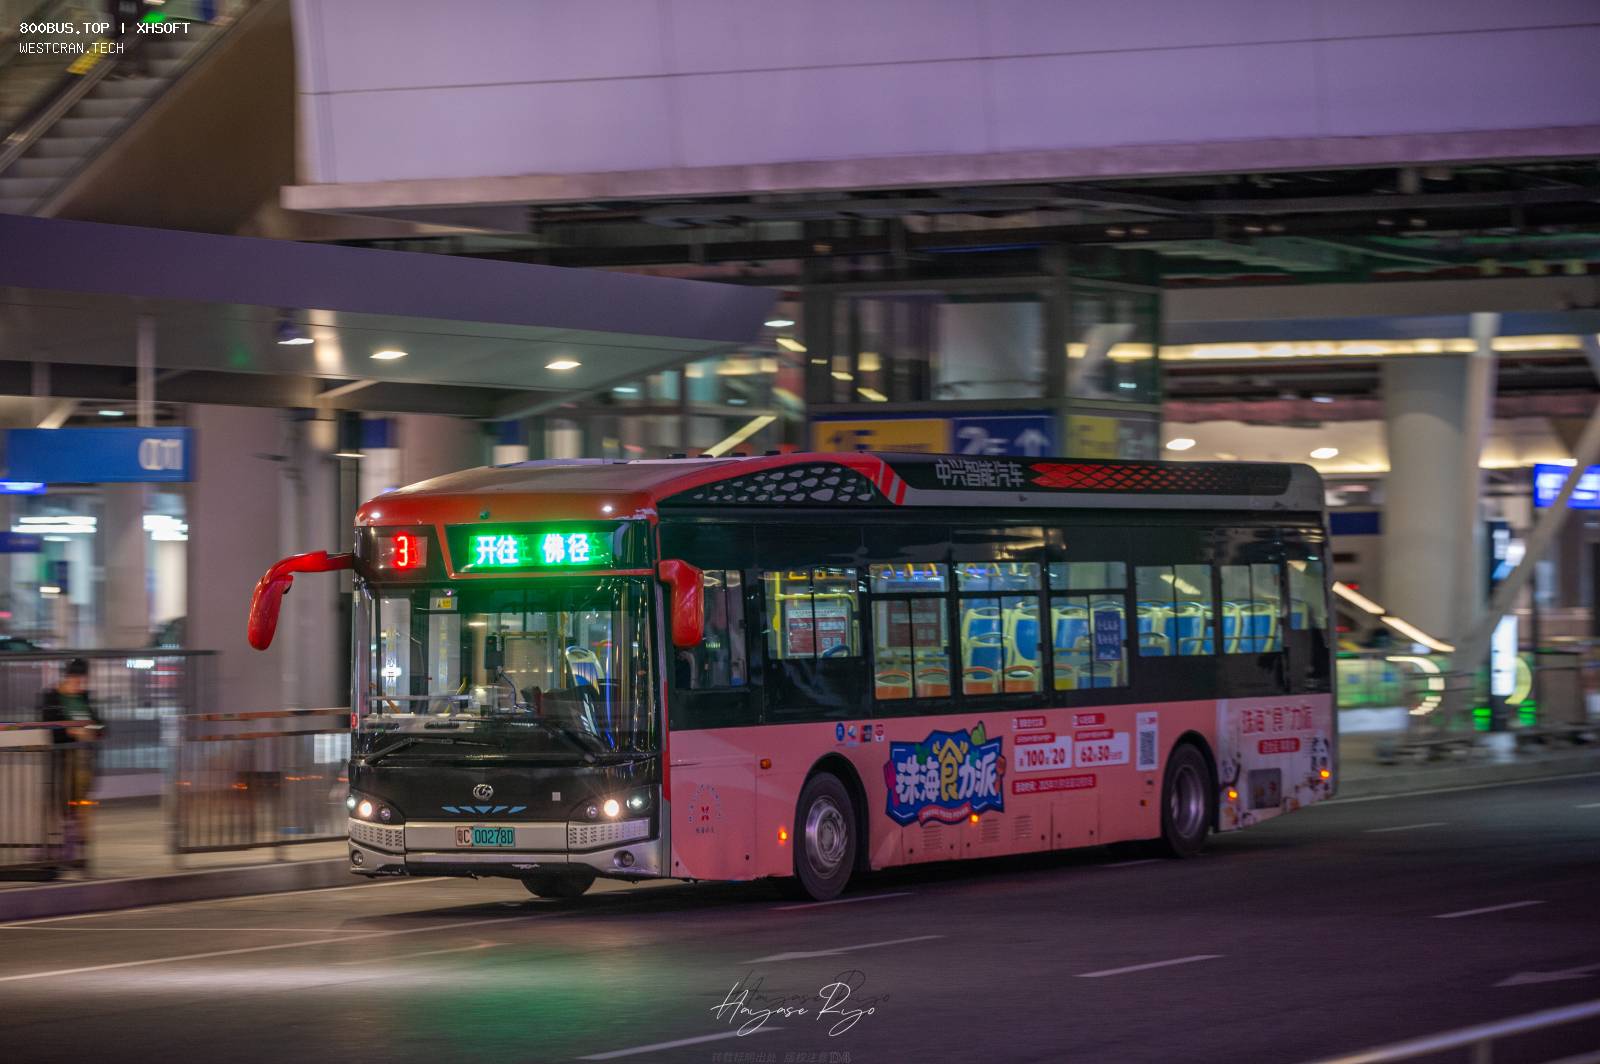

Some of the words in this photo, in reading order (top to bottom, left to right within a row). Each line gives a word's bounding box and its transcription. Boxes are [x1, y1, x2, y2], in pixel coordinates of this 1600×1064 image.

[935, 458, 1025, 488] 中兴智能汽车
[396, 535, 409, 567] 3
[476, 535, 519, 565] 开往
[543, 534, 590, 564] 佛径
